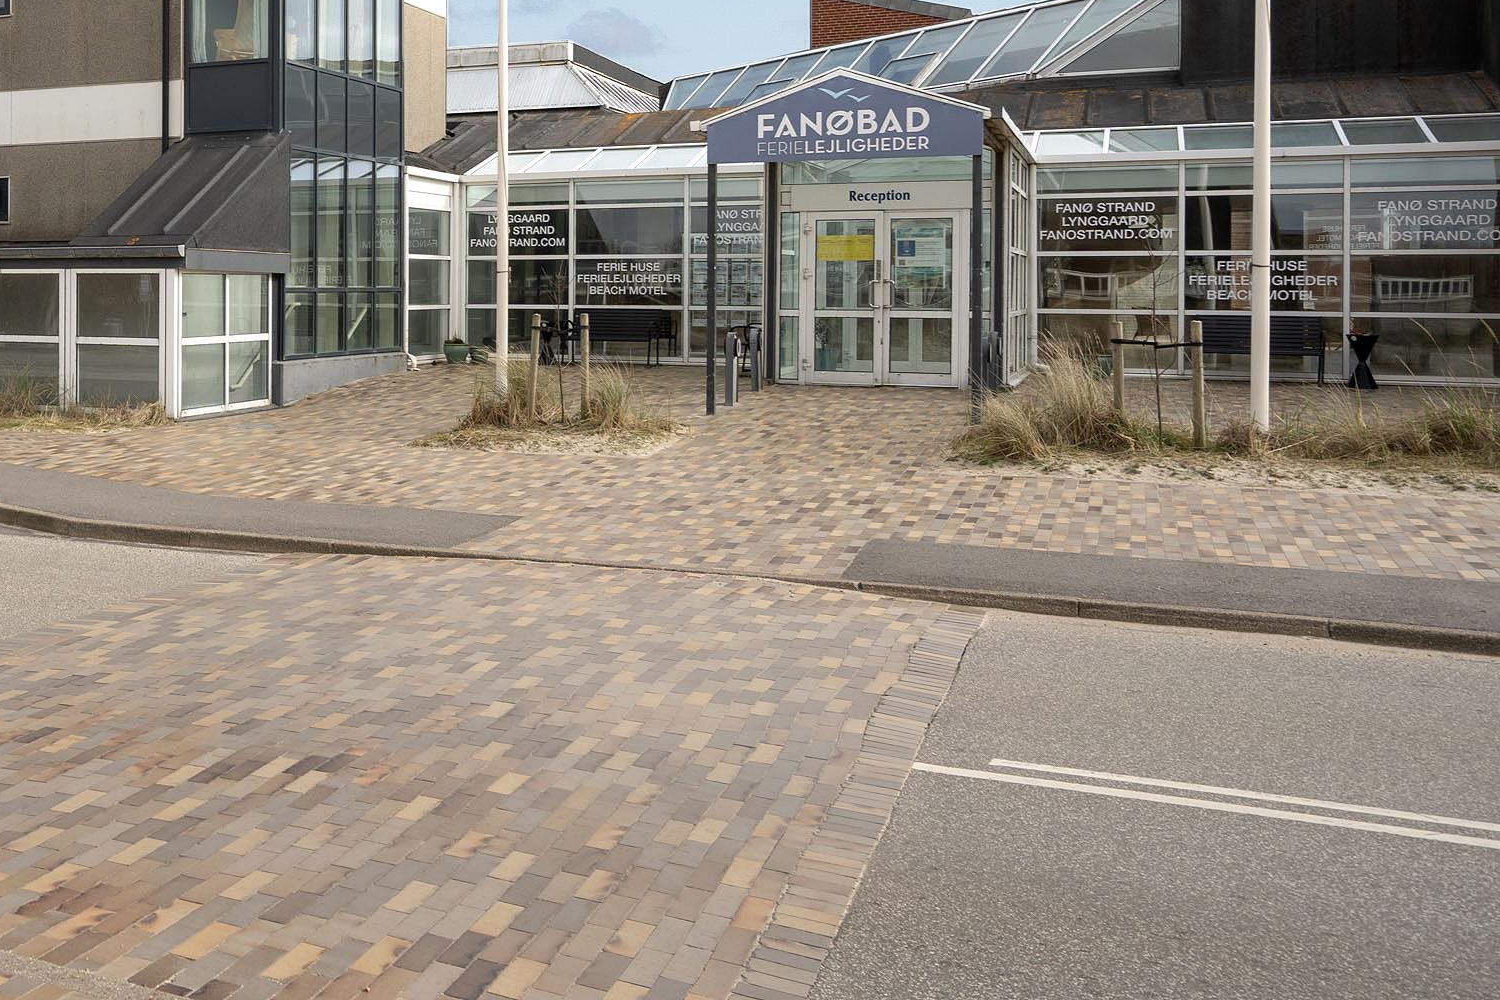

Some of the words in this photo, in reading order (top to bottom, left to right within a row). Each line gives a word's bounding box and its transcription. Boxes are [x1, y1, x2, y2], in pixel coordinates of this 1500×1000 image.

[757, 107, 930, 138] FANØBAD
[757, 136, 929, 156] FERIELEJLIGHEDER
[849, 190, 910, 203] Reception
[1055, 203, 1093, 213] FANØ
[1096, 202, 1156, 212] STRAND
[1377, 200, 1422, 211] FANØ
[1427, 199, 1497, 210] STRAND
[488, 214, 550, 224] LYGGAARD
[1062, 215, 1149, 226] LYNGGAARD
[512, 226, 555, 235] STRAND
[1040, 228, 1173, 240] FANOSTRAND.COM
[1358, 230, 1500, 242] FANOSTRAND.CO
[470, 238, 565, 248] FANORAND.COM
[597, 263, 628, 272] FERIE
[630, 262, 661, 271] HUSE
[1217, 261, 1251, 271] FERI
[577, 274, 681, 283] FERIELEJLIGHEDER
[1188, 275, 1338, 286] FERIELEGHEDER
[589, 286, 626, 295] BEACH
[629, 286, 668, 295] MOTEL
